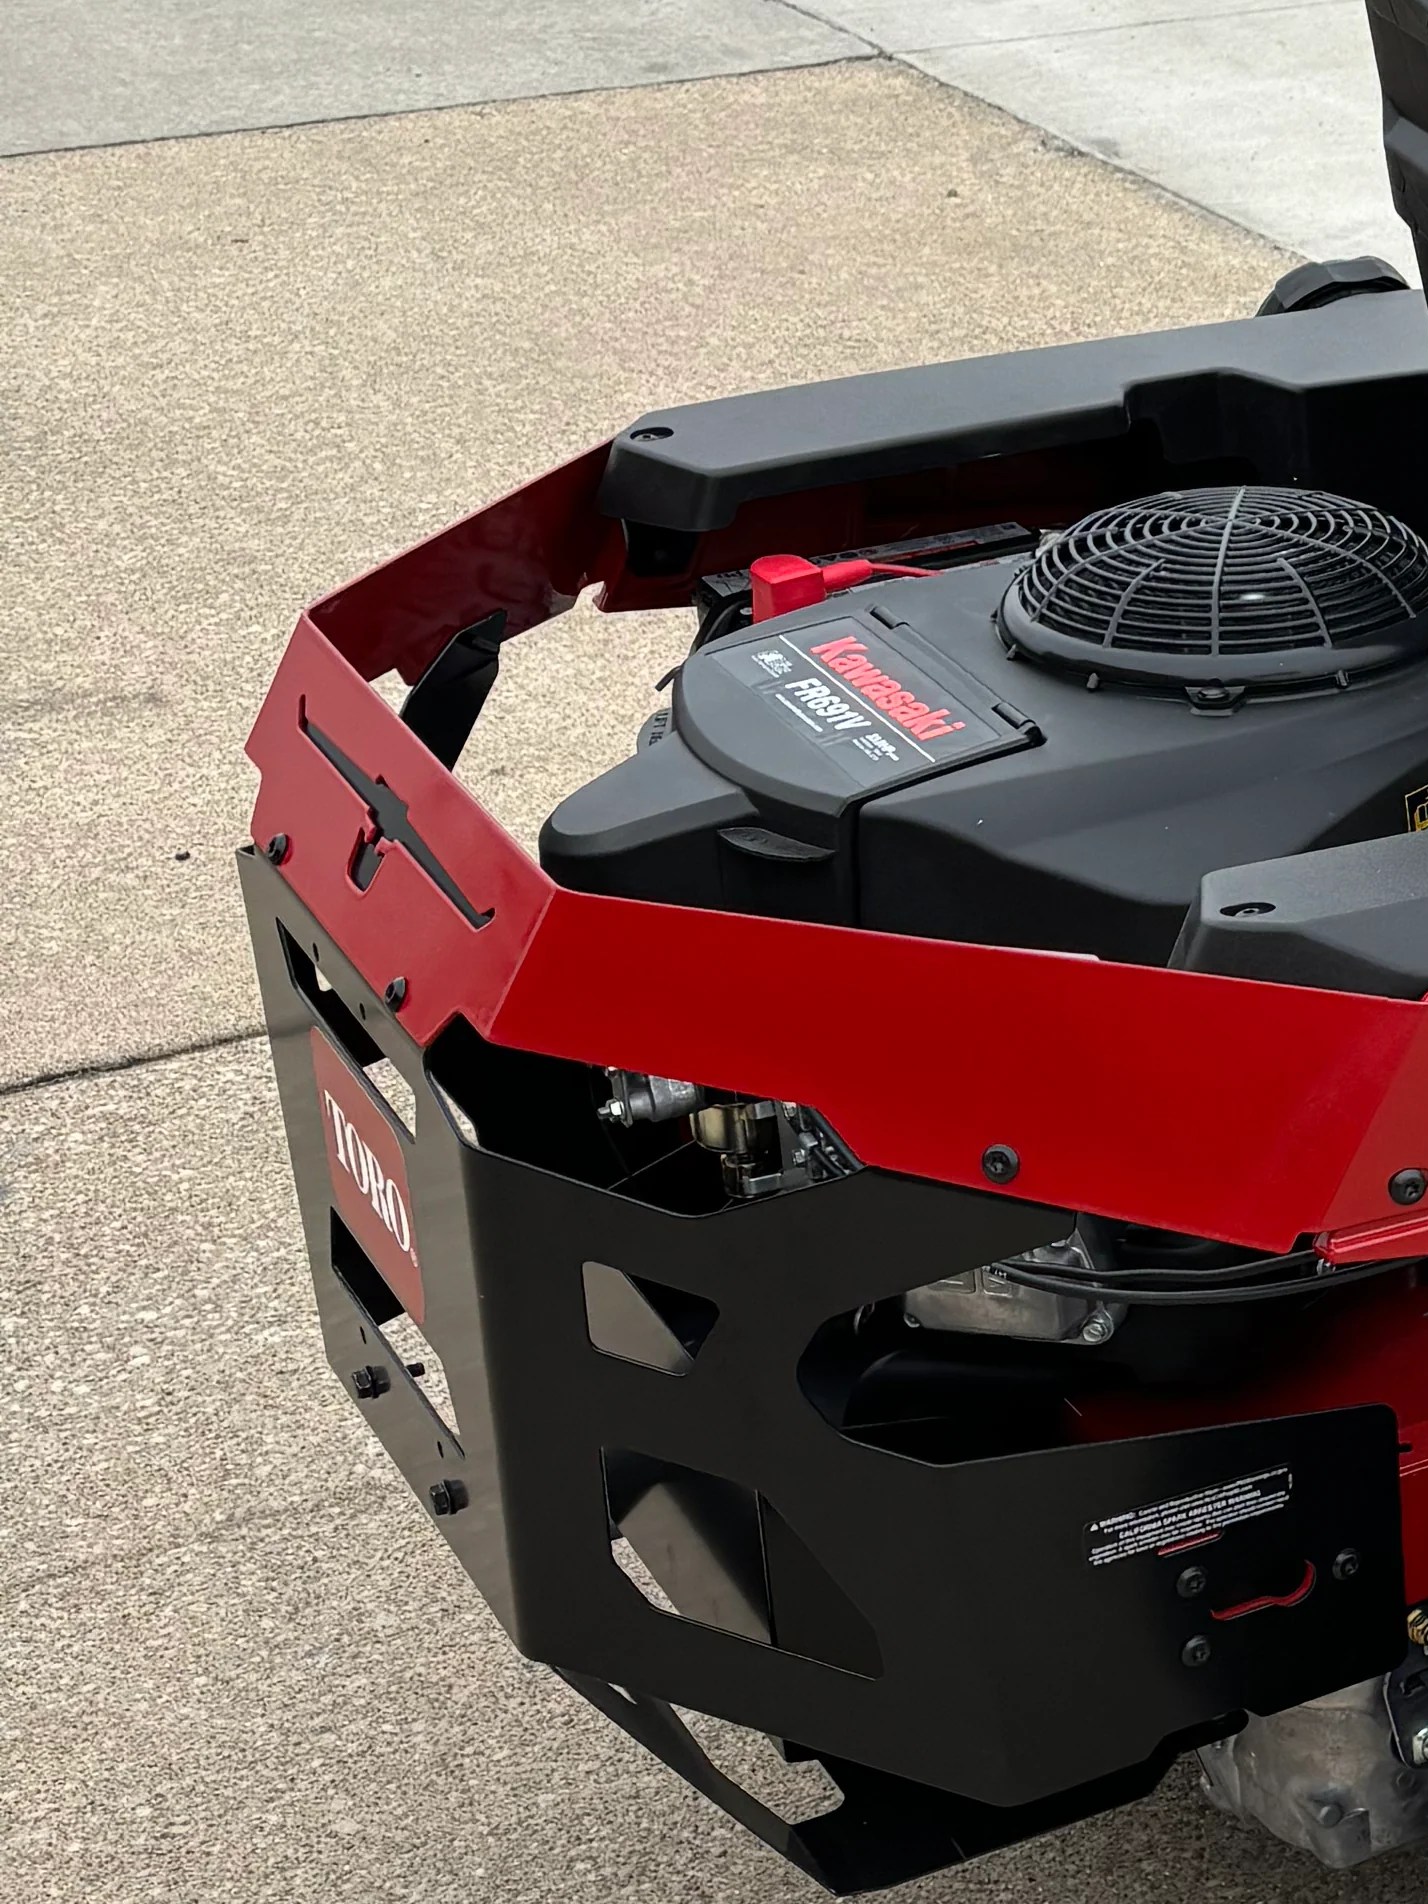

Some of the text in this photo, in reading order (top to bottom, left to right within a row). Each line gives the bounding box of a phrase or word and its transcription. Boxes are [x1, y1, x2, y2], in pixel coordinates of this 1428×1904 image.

[785, 678, 872, 730] FR691V
[811, 636, 966, 741] Kawasaki
[324, 1089, 410, 1252] TORO
